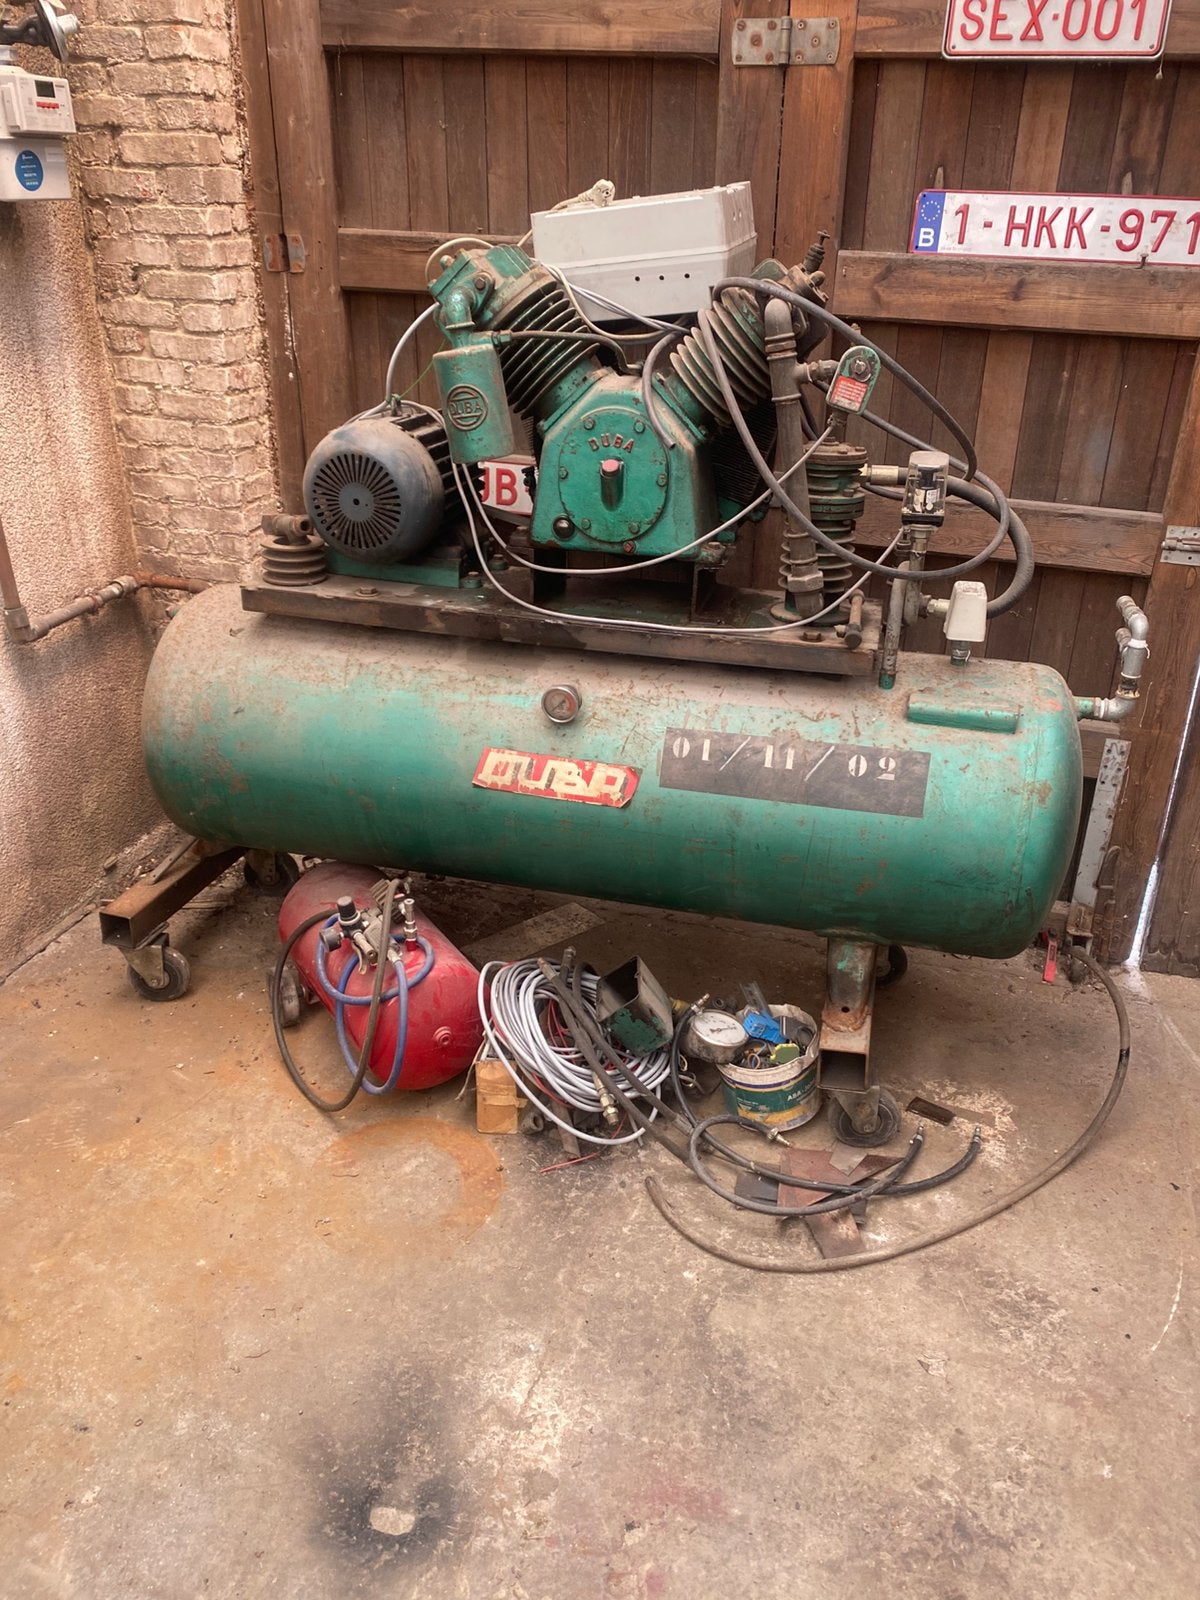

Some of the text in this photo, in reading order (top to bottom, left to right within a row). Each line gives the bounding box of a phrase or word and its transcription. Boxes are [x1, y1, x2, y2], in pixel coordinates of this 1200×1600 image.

[918, 227, 935, 247] B
[955, 203, 1200, 255] 1-HKK-971
[448, 399, 483, 416] DUBA
[587, 433, 635, 454] DUBA
